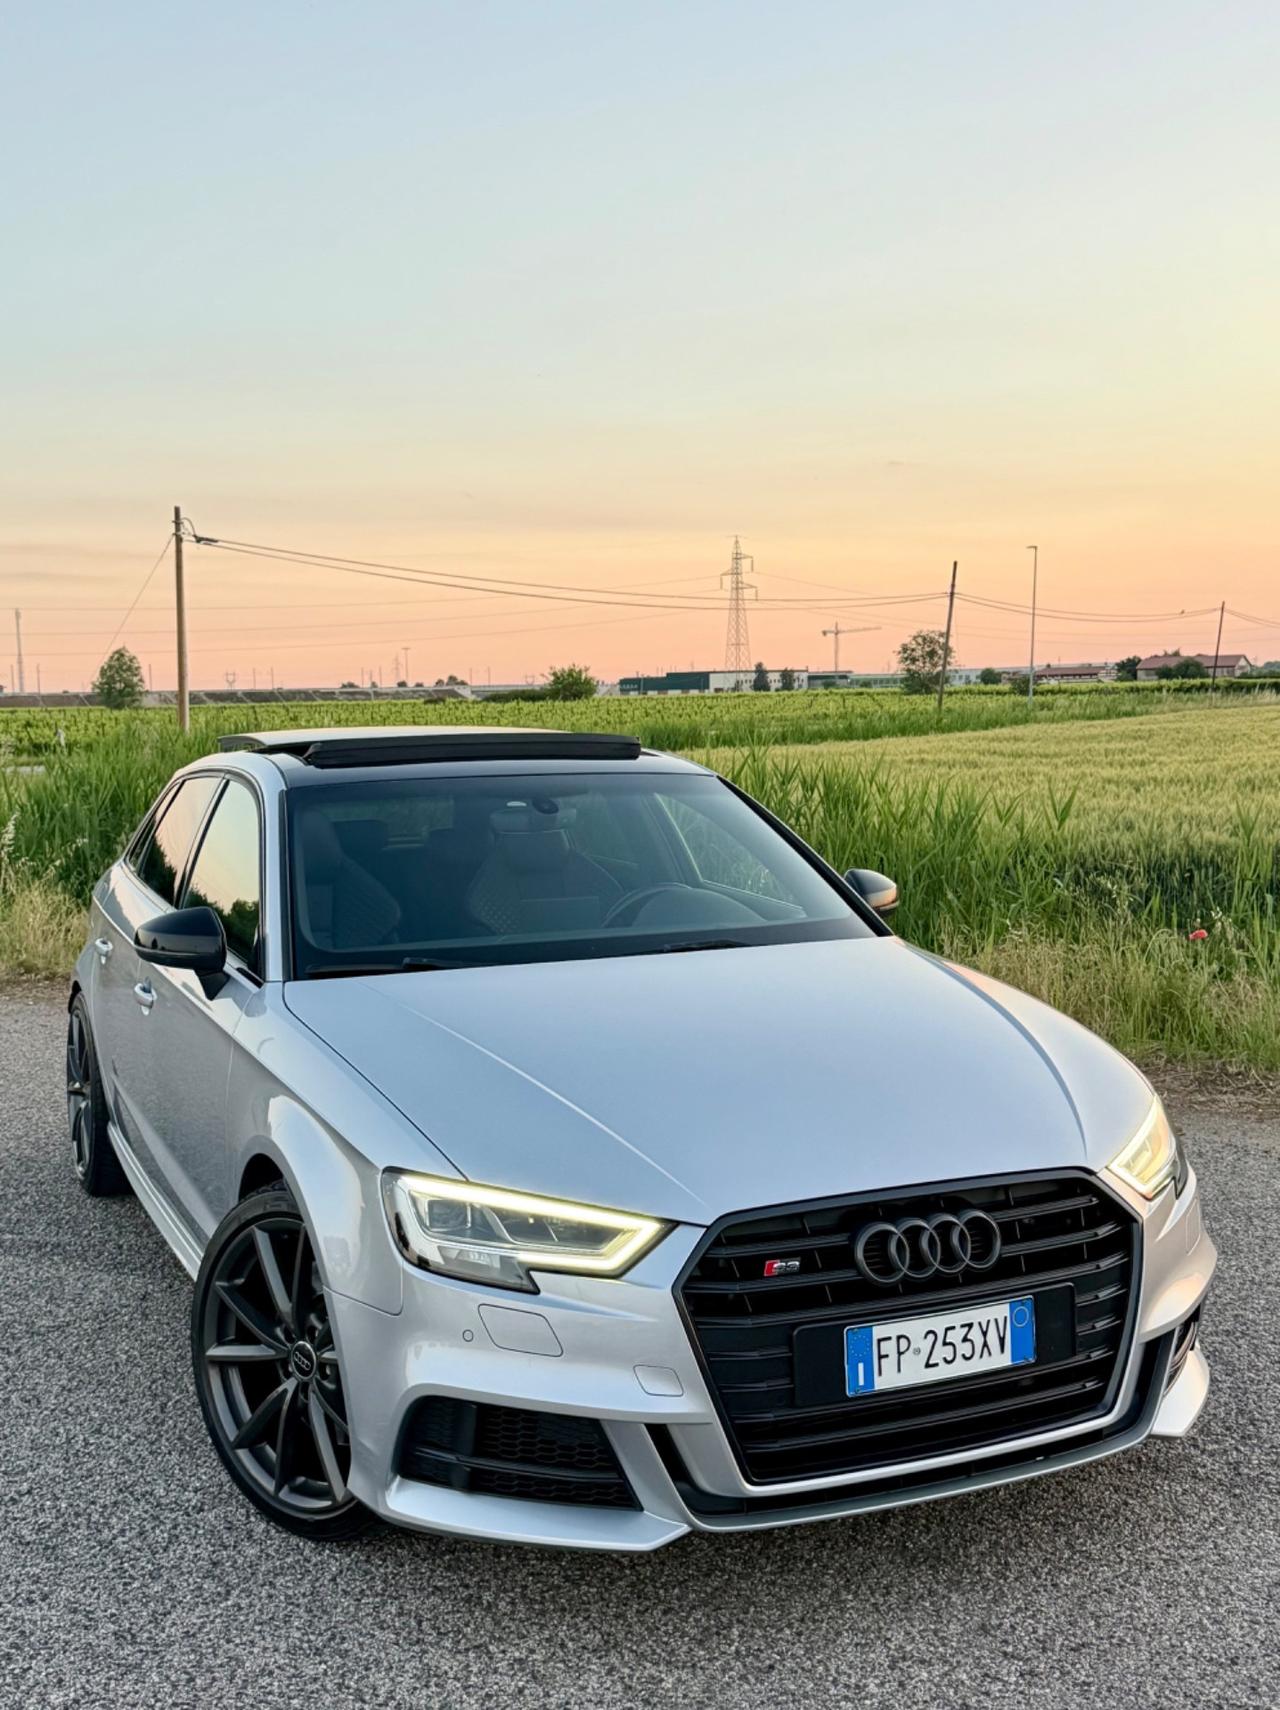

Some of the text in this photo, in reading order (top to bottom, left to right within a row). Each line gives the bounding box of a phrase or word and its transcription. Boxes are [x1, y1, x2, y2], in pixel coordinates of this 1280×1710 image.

[877, 1315, 1008, 1377] FP 253XV
[857, 1362, 864, 1386] I
